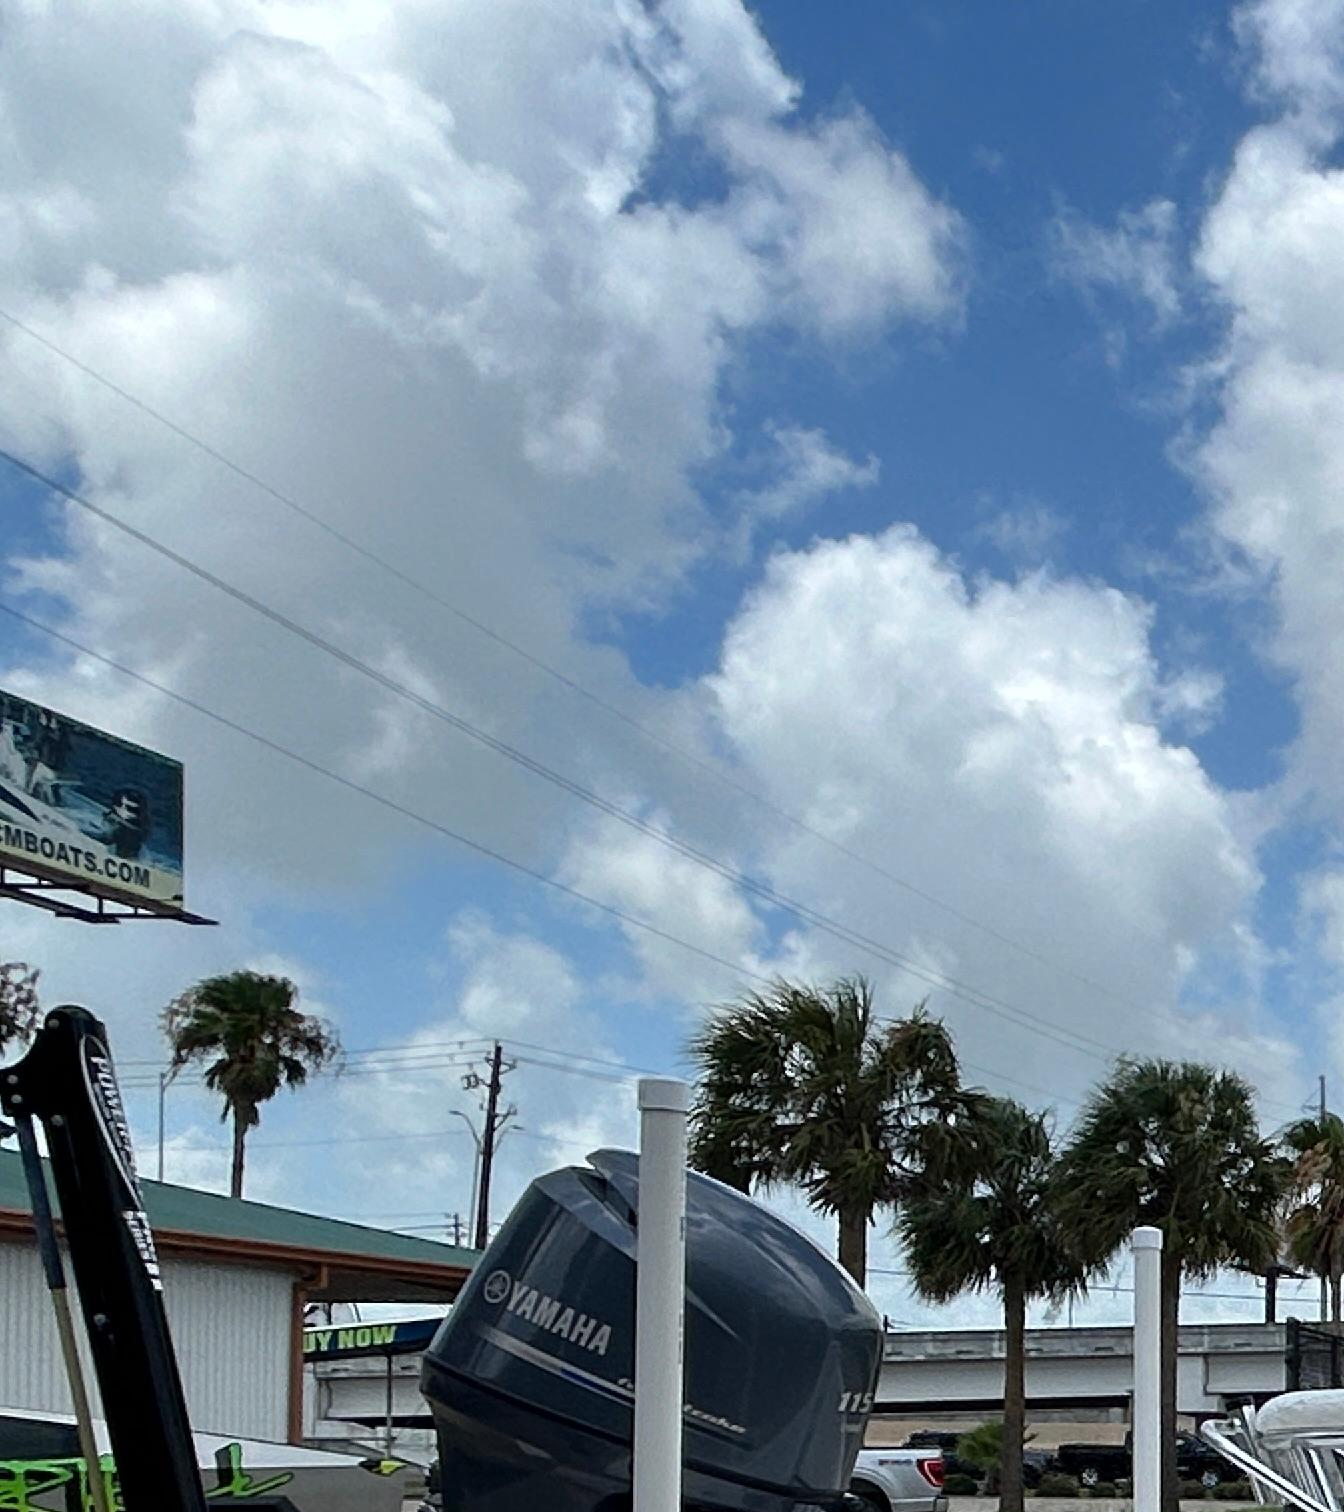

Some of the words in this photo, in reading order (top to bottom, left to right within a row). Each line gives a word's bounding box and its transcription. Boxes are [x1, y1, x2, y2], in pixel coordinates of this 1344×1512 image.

[0, 824, 149, 888] MBOATS.COM
[337, 1325, 397, 1349] NOW
[507, 1280, 612, 1356] YAMAHA
[838, 1392, 874, 1413] 115
